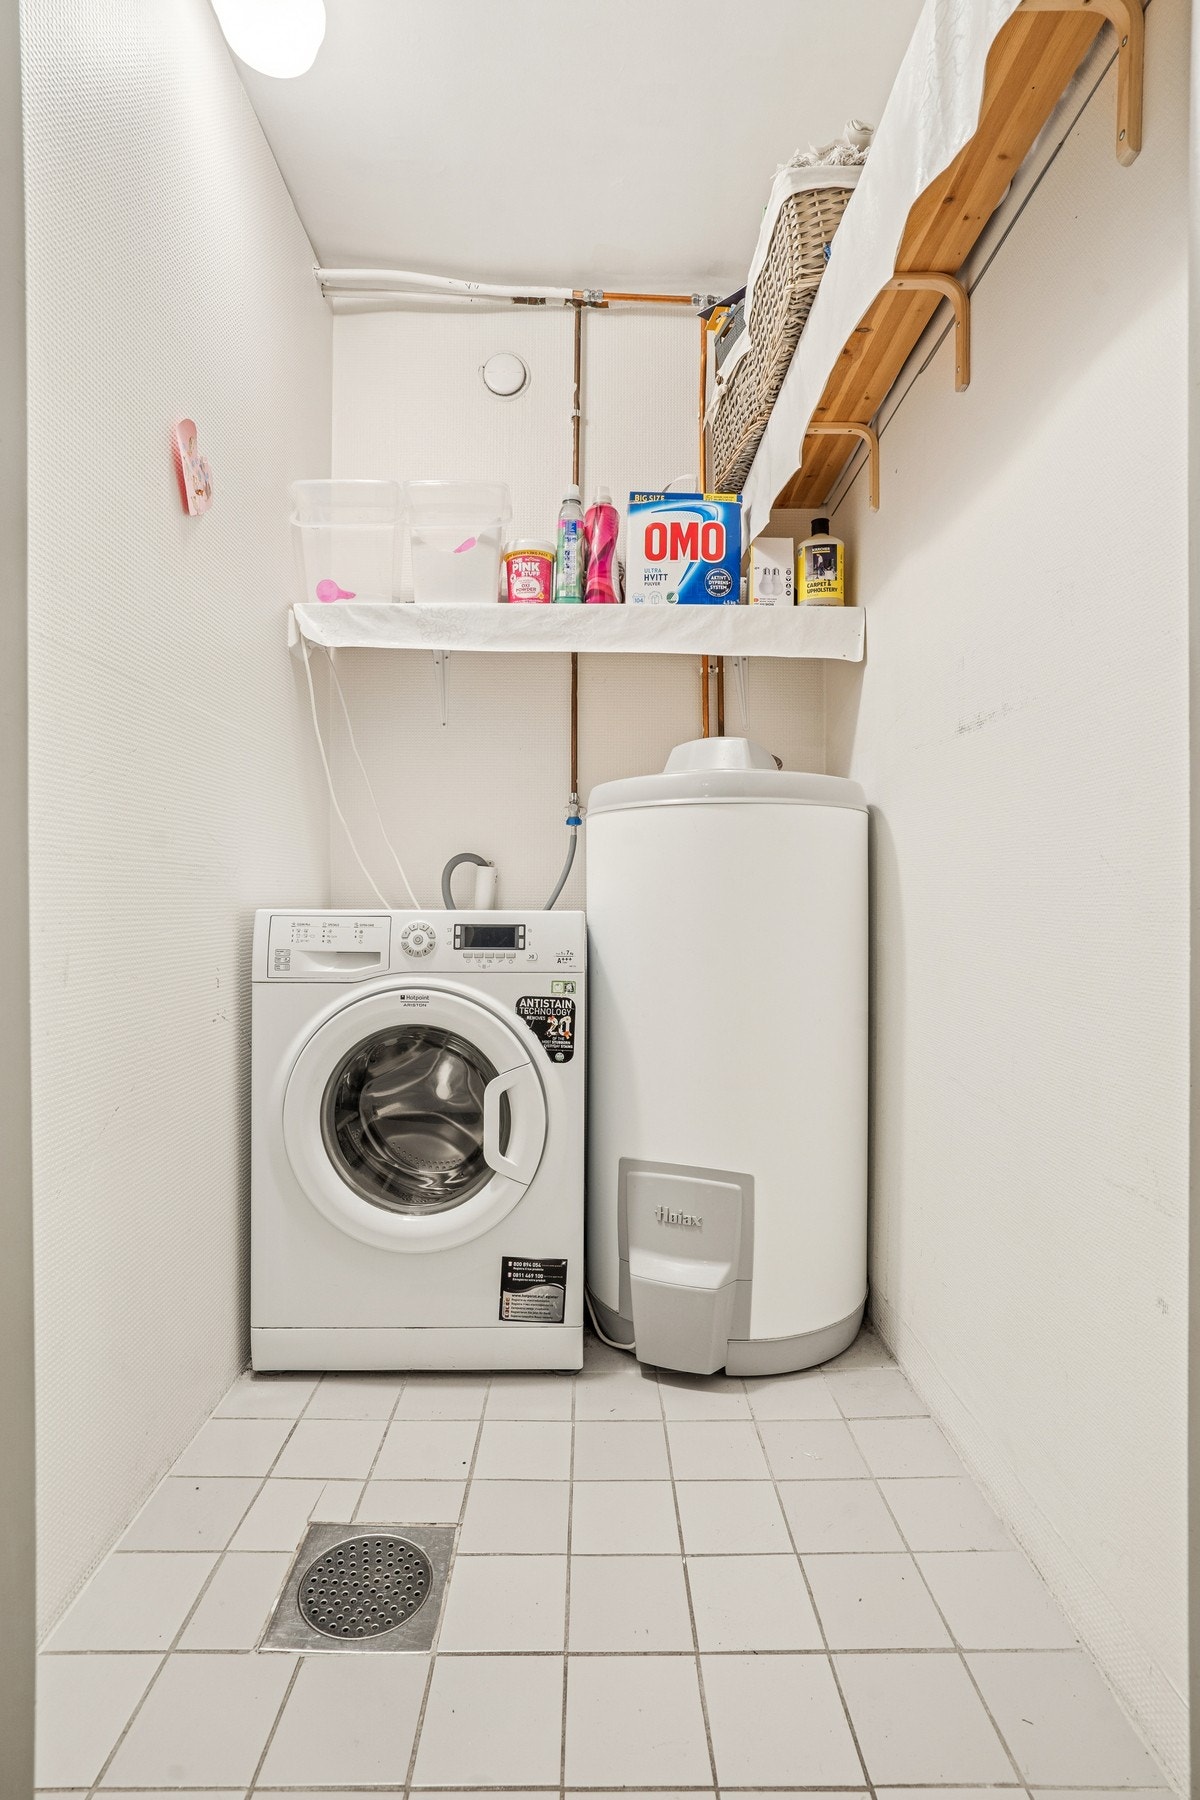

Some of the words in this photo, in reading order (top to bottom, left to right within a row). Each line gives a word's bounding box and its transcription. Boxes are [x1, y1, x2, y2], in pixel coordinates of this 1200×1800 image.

[634, 494, 648, 502] BIG
[645, 522, 724, 562] OMO
[512, 562, 540, 573] PINK
[519, 998, 573, 1009] ANTISTAIN
[519, 1007, 572, 1016] TECHNOLOGY
